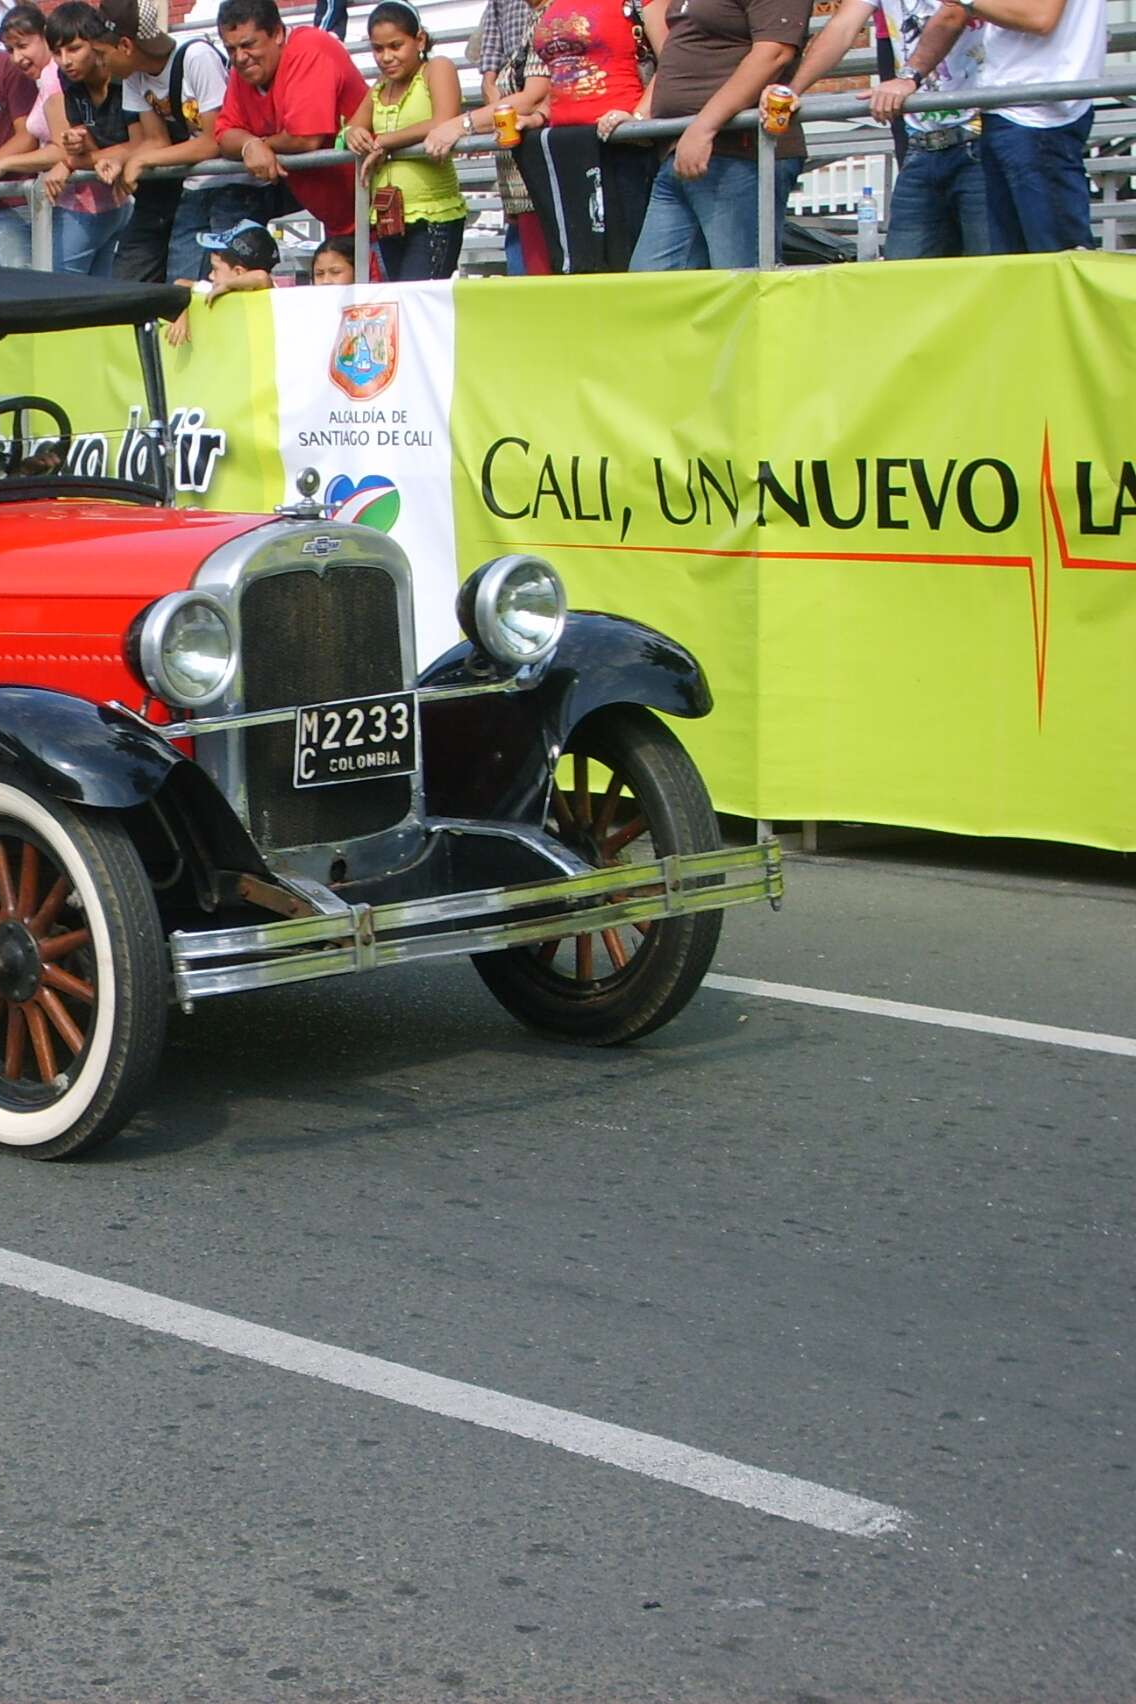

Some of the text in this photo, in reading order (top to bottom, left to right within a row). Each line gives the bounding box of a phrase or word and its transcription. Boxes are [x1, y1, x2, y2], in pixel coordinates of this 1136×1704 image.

[329, 406, 407, 423] ALCALDÍA DE
[298, 430, 433, 447] SANTIAGO DE CALI
[653, 456, 739, 528] UN
[757, 457, 1020, 533] NUEVO
[329, 750, 401, 773] COLOMBIA
